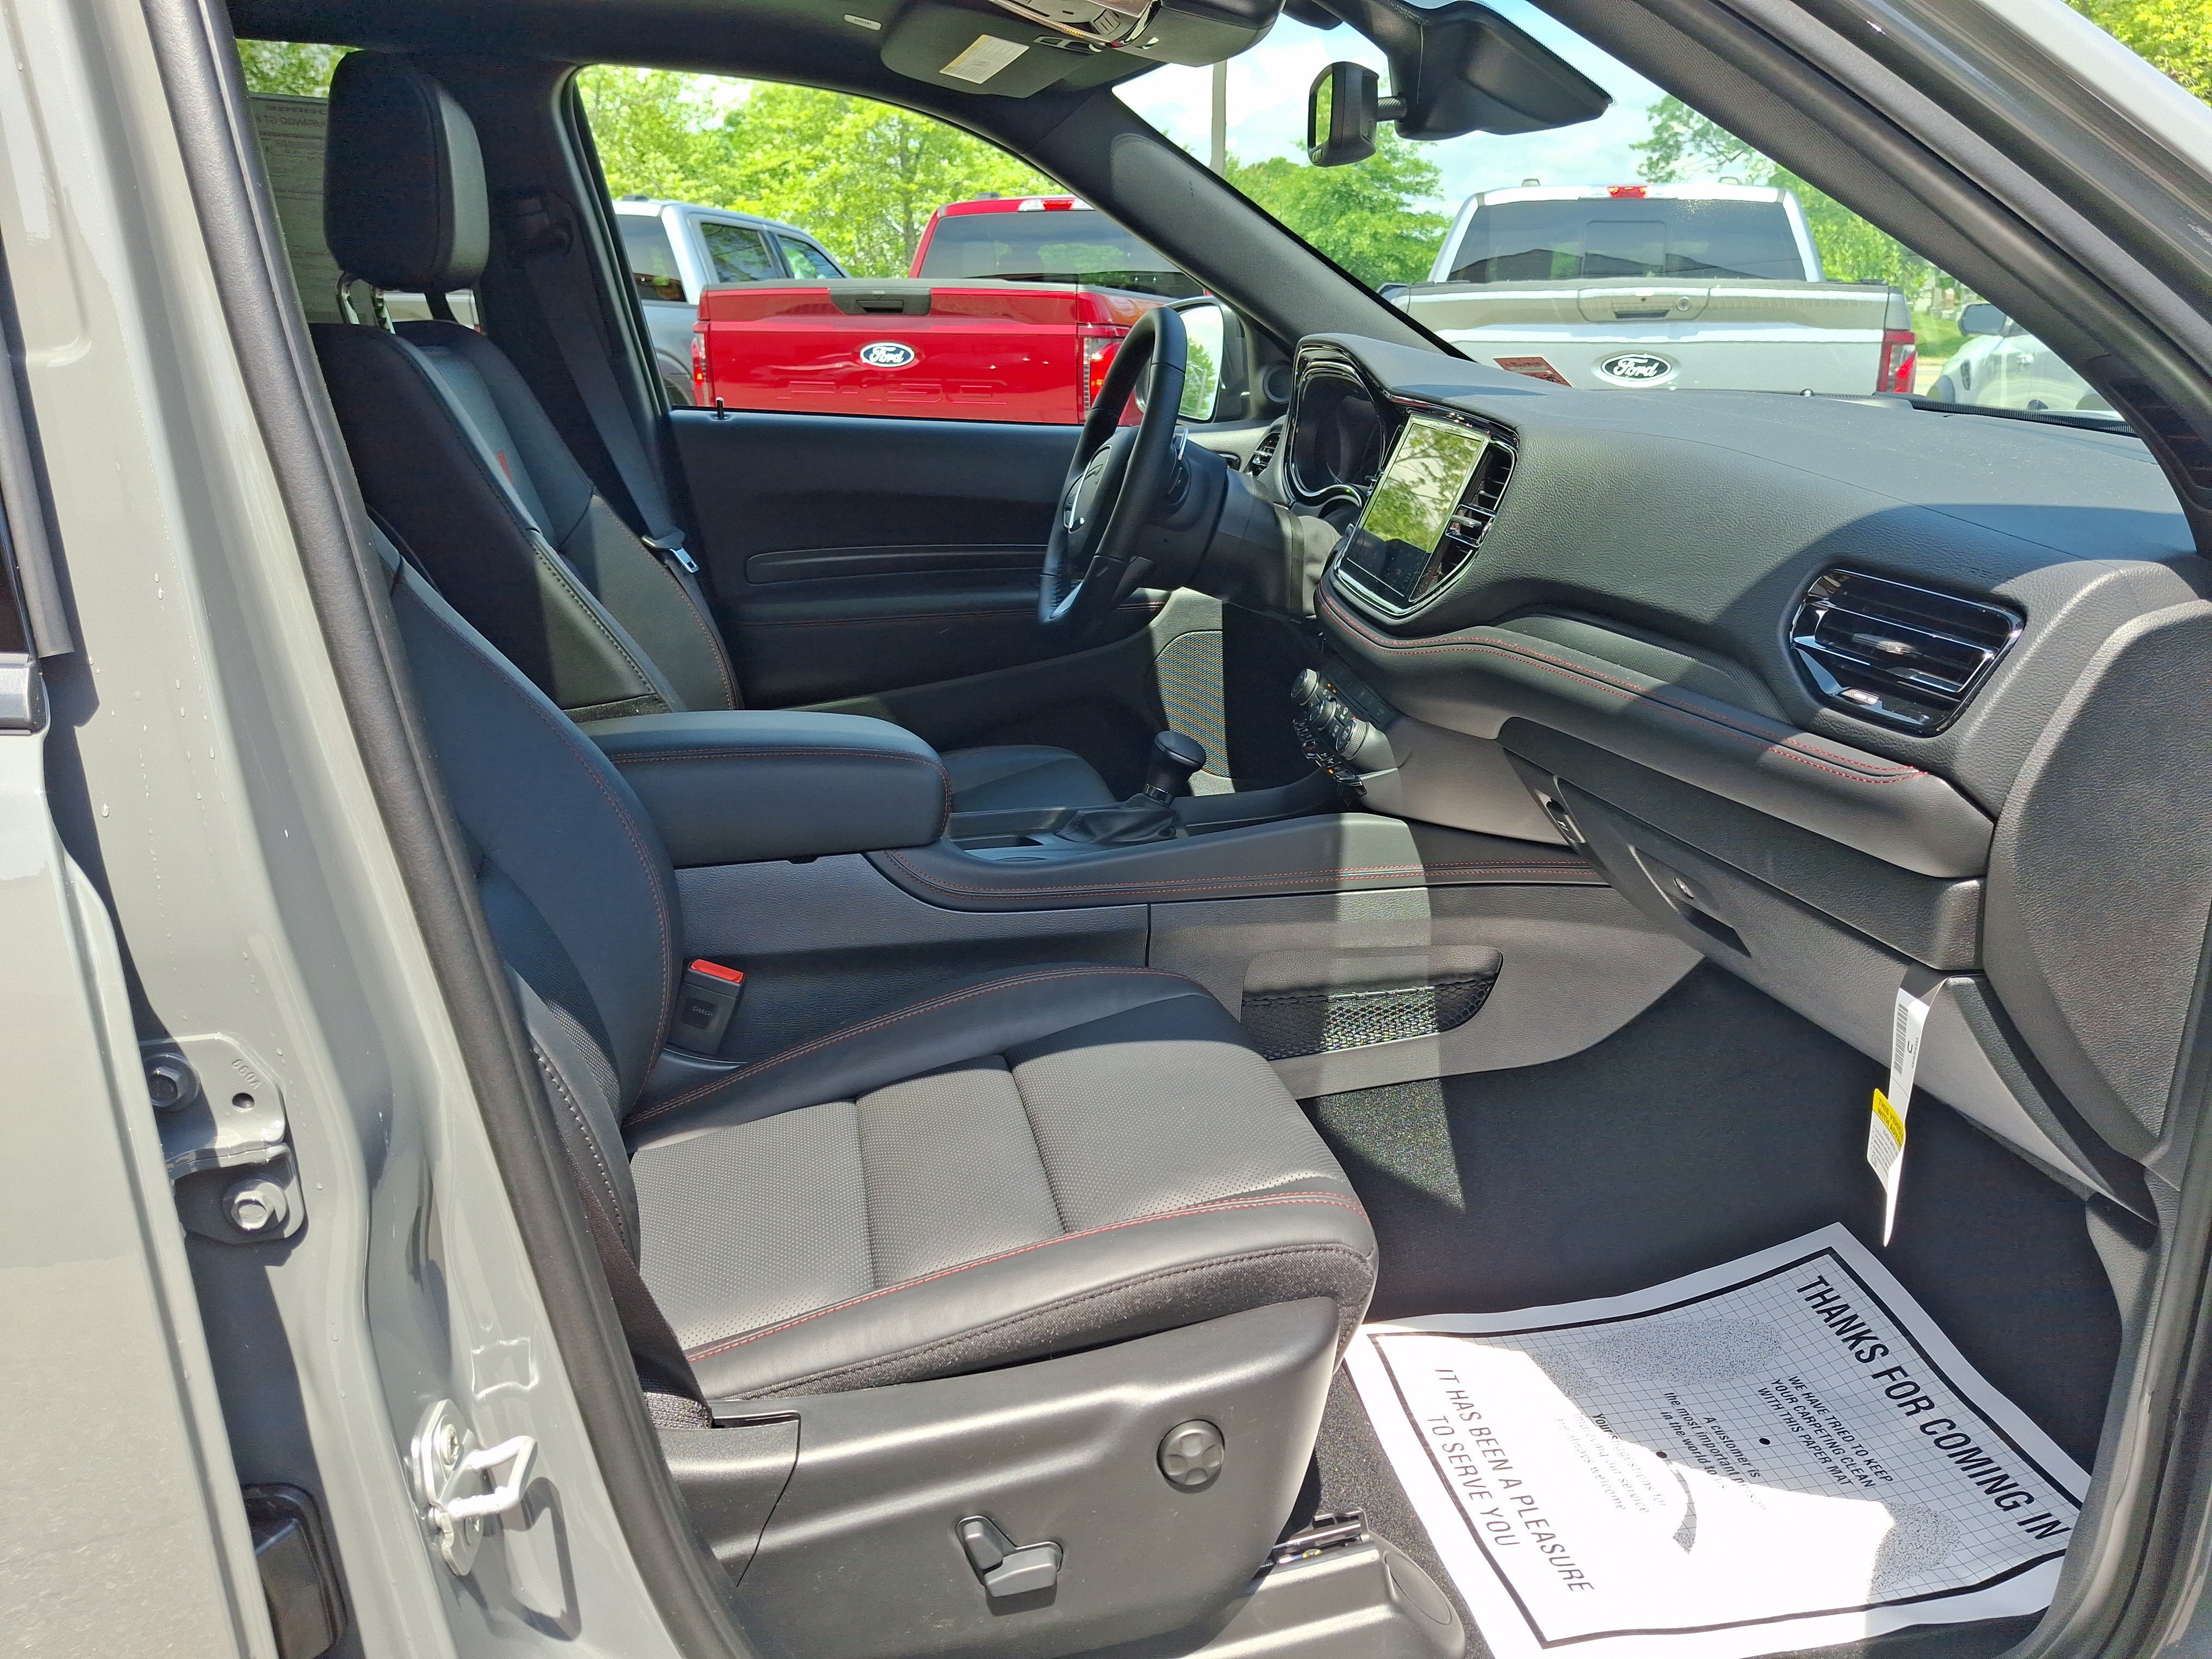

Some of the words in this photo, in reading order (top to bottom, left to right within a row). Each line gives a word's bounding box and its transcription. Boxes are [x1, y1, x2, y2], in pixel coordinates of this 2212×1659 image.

[869, 346, 905, 363] Ford
[1612, 357, 1660, 377] Ford
[1877, 1108, 1889, 1126] WITH
[1879, 1098, 1889, 1114] THIS
[1435, 1369, 1461, 1384] IT
[1445, 1390, 1482, 1422] HAS
[1592, 1413, 1613, 1435] Your
[1796, 1275, 1889, 1364] THANKS
[1871, 1365, 1934, 1417] FOR
[1919, 1417, 2035, 1512] COMING
[2016, 1512, 2072, 1540] IN
[1468, 1426, 1513, 1471] BEEN
[1660, 1411, 1674, 1420] in
[1669, 1422, 1686, 1437] the
[1682, 1438, 1712, 1464] world
[1704, 1465, 1718, 1475] to
[1664, 1392, 1681, 1406] the
[1677, 1408, 1703, 1430] most
[1696, 1431, 1740, 1476] important
[1757, 1386, 1784, 1411] WITH
[1779, 1410, 1804, 1433] THIS
[1798, 1433, 1832, 1465] PAPER
[1826, 1464, 1854, 1486] MAT
[1771, 1379, 1797, 1405] YOUR
[1793, 1405, 1846, 1456] CARPETING
[1841, 1456, 1876, 1488] CLEAN
[1788, 1375, 1808, 1392] WE
[1801, 1391, 1830, 1416] HAVE
[1824, 1414, 1855, 1444] TRIED
[1851, 1439, 1869, 1458] TO
[1863, 1457, 1894, 1483] KEEP
[1711, 1425, 1752, 1467] customer
[1747, 1469, 1760, 1478] is
[1427, 1415, 1455, 1436] TO
[1441, 1442, 1493, 1501] SERVE
[1480, 1507, 1521, 1546] YOU
[1498, 1478, 1523, 1489] A
[1591, 1467, 1626, 1510] welcome
[1618, 1478, 1649, 1513] service
[1509, 1494, 1595, 1592] PLEASURE
